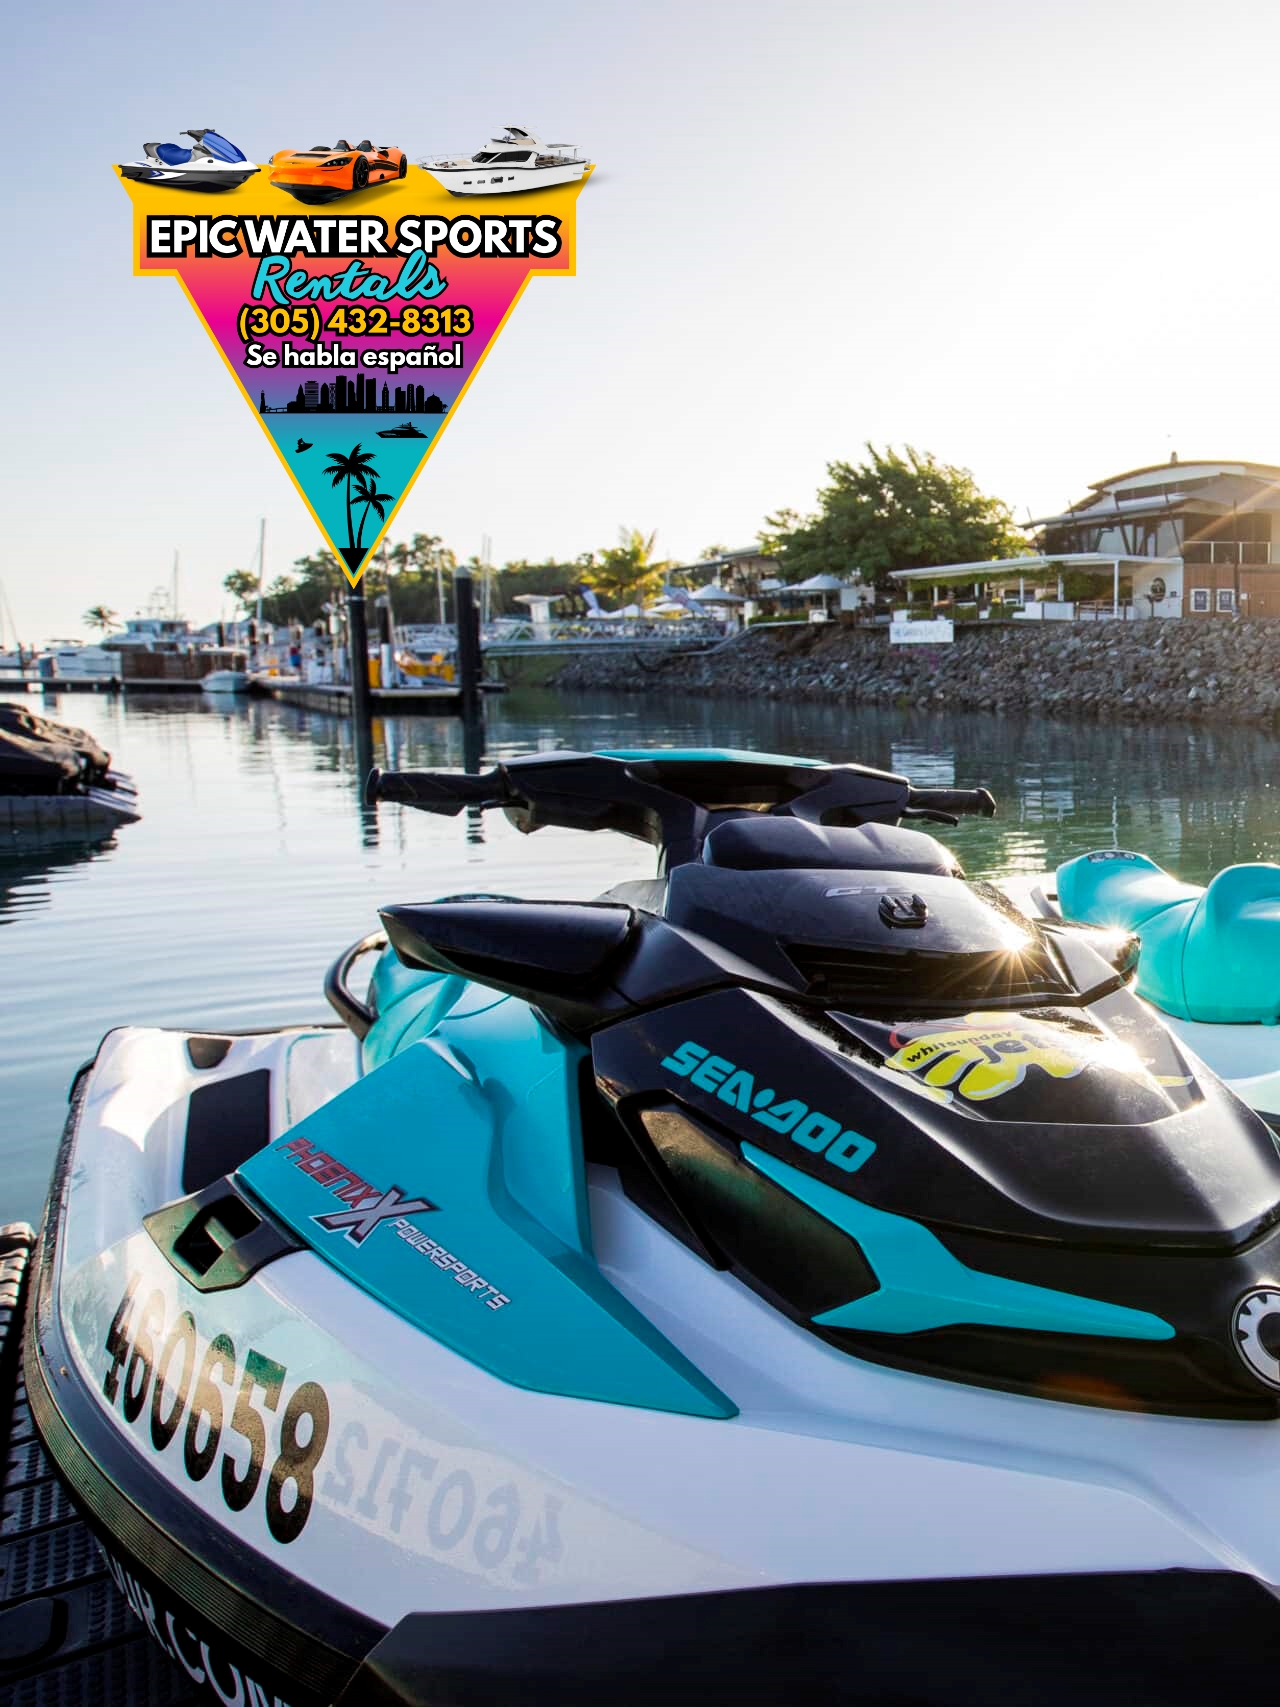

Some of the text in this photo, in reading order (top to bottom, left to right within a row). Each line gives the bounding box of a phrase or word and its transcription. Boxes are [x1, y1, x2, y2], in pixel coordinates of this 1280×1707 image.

[906, 1030, 1013, 1063] whitsunday
[276, 1136, 383, 1210] PHOENIX
[387, 1216, 512, 1311] POWERSPORTS
[102, 1272, 330, 1545] 460658
